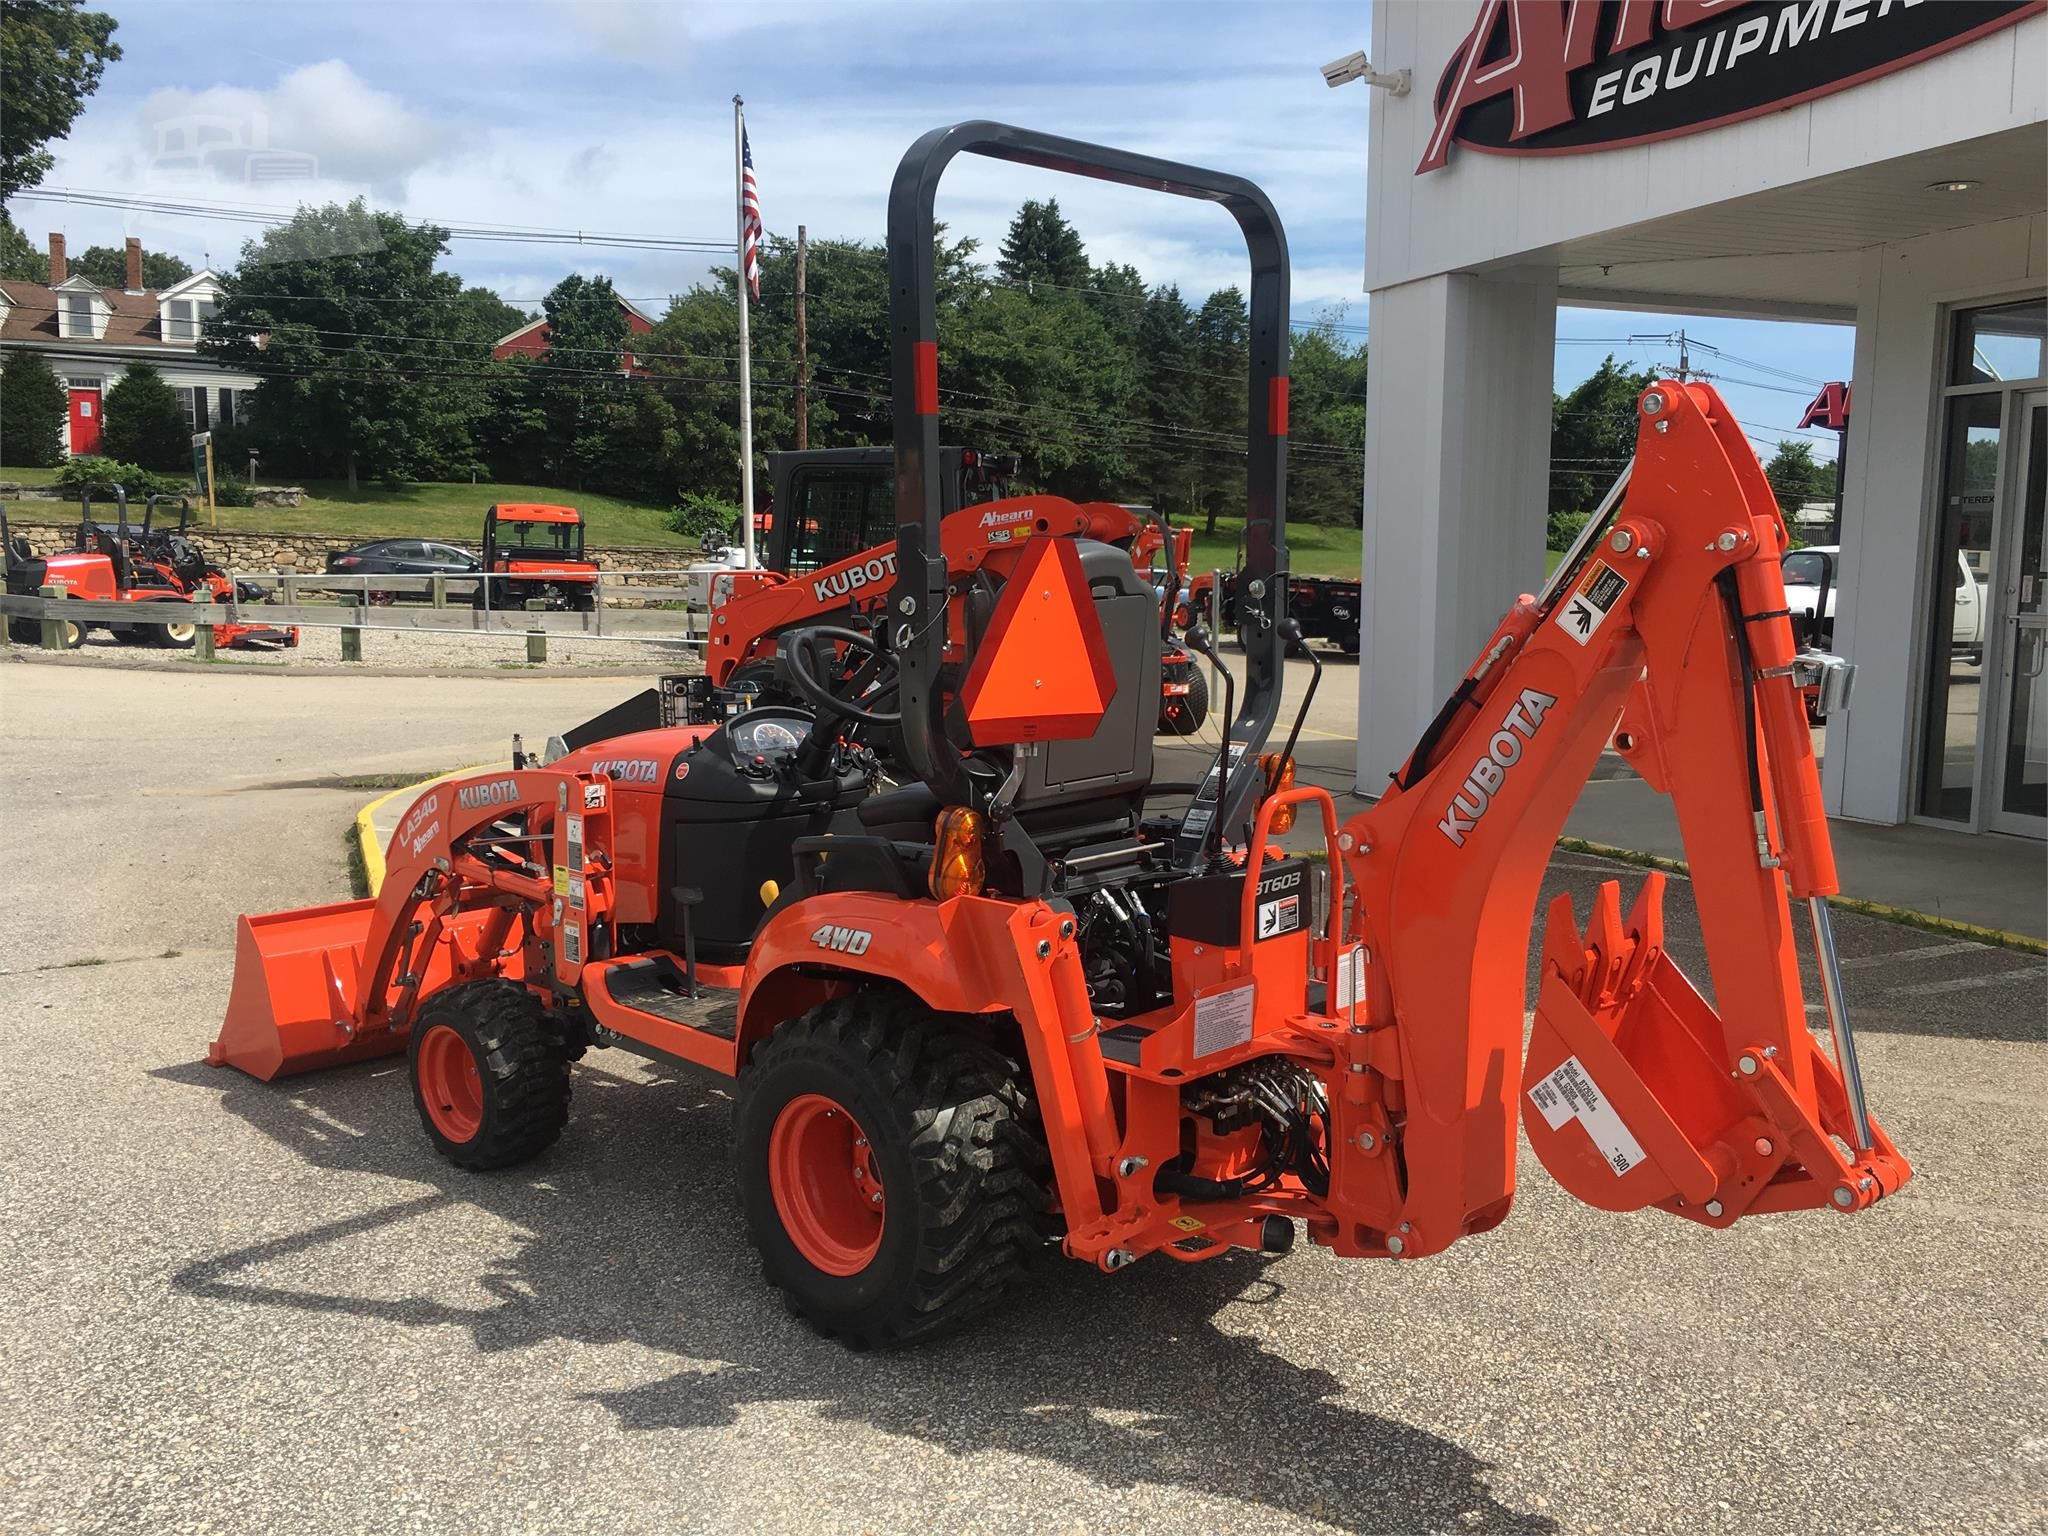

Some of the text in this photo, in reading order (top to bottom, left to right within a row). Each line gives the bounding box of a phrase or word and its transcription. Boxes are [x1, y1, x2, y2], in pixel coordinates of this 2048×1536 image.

[979, 509, 1033, 528] Ahearn
[813, 552, 897, 602] KUBOT
[1437, 688, 1558, 848] KUBOTA
[459, 780, 520, 809] KUBOTA
[399, 795, 438, 848] LA340
[413, 820, 440, 858] Ahearn
[811, 924, 872, 955] 4WD
[1554, 1069, 1566, 1081] S/N
[1565, 1060, 1581, 1079] Model
[1613, 1153, 1630, 1172] 500
